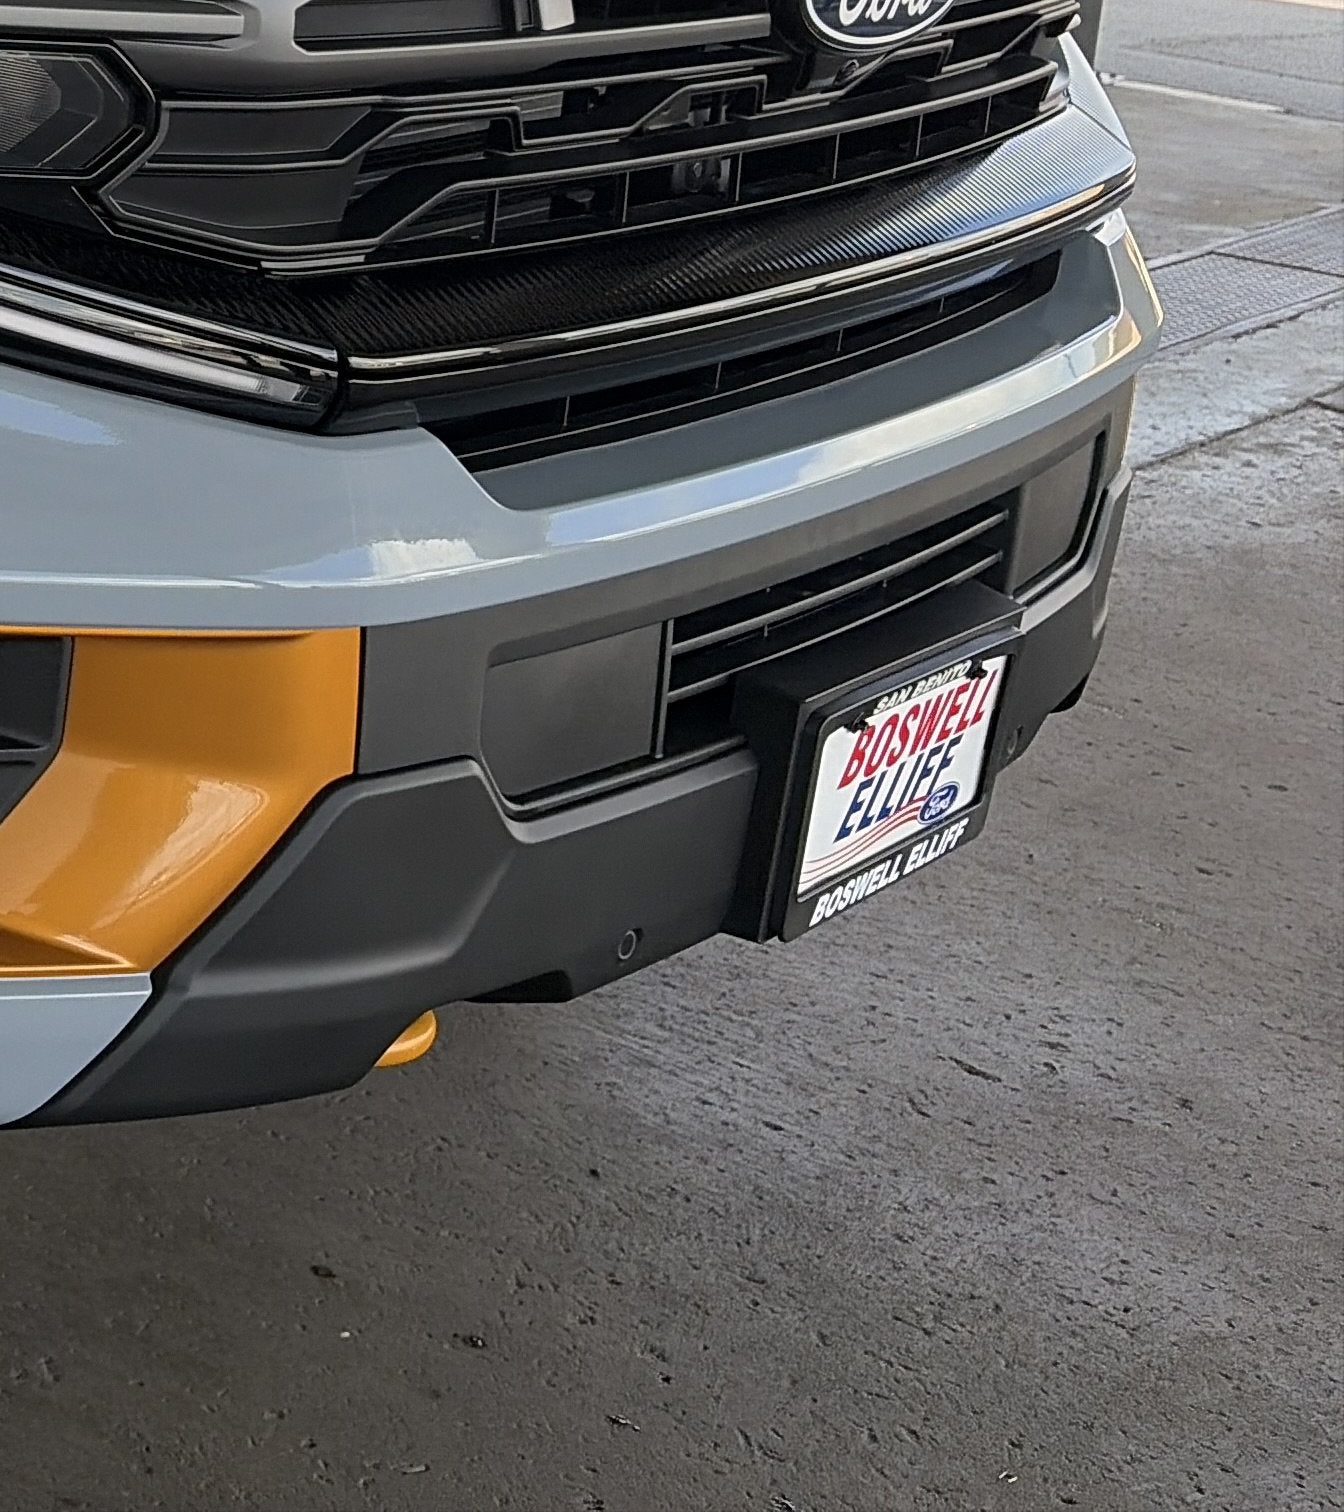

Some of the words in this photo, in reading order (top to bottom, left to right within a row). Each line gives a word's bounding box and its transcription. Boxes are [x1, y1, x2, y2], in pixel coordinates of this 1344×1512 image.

[837, 668, 999, 790] BOSWELL
[873, 686, 911, 714] SAN
[911, 660, 972, 697] BENITO
[833, 734, 964, 843] ELLIFF
[809, 855, 902, 927] BOSWELL
[903, 818, 969, 875] ELLIFF
